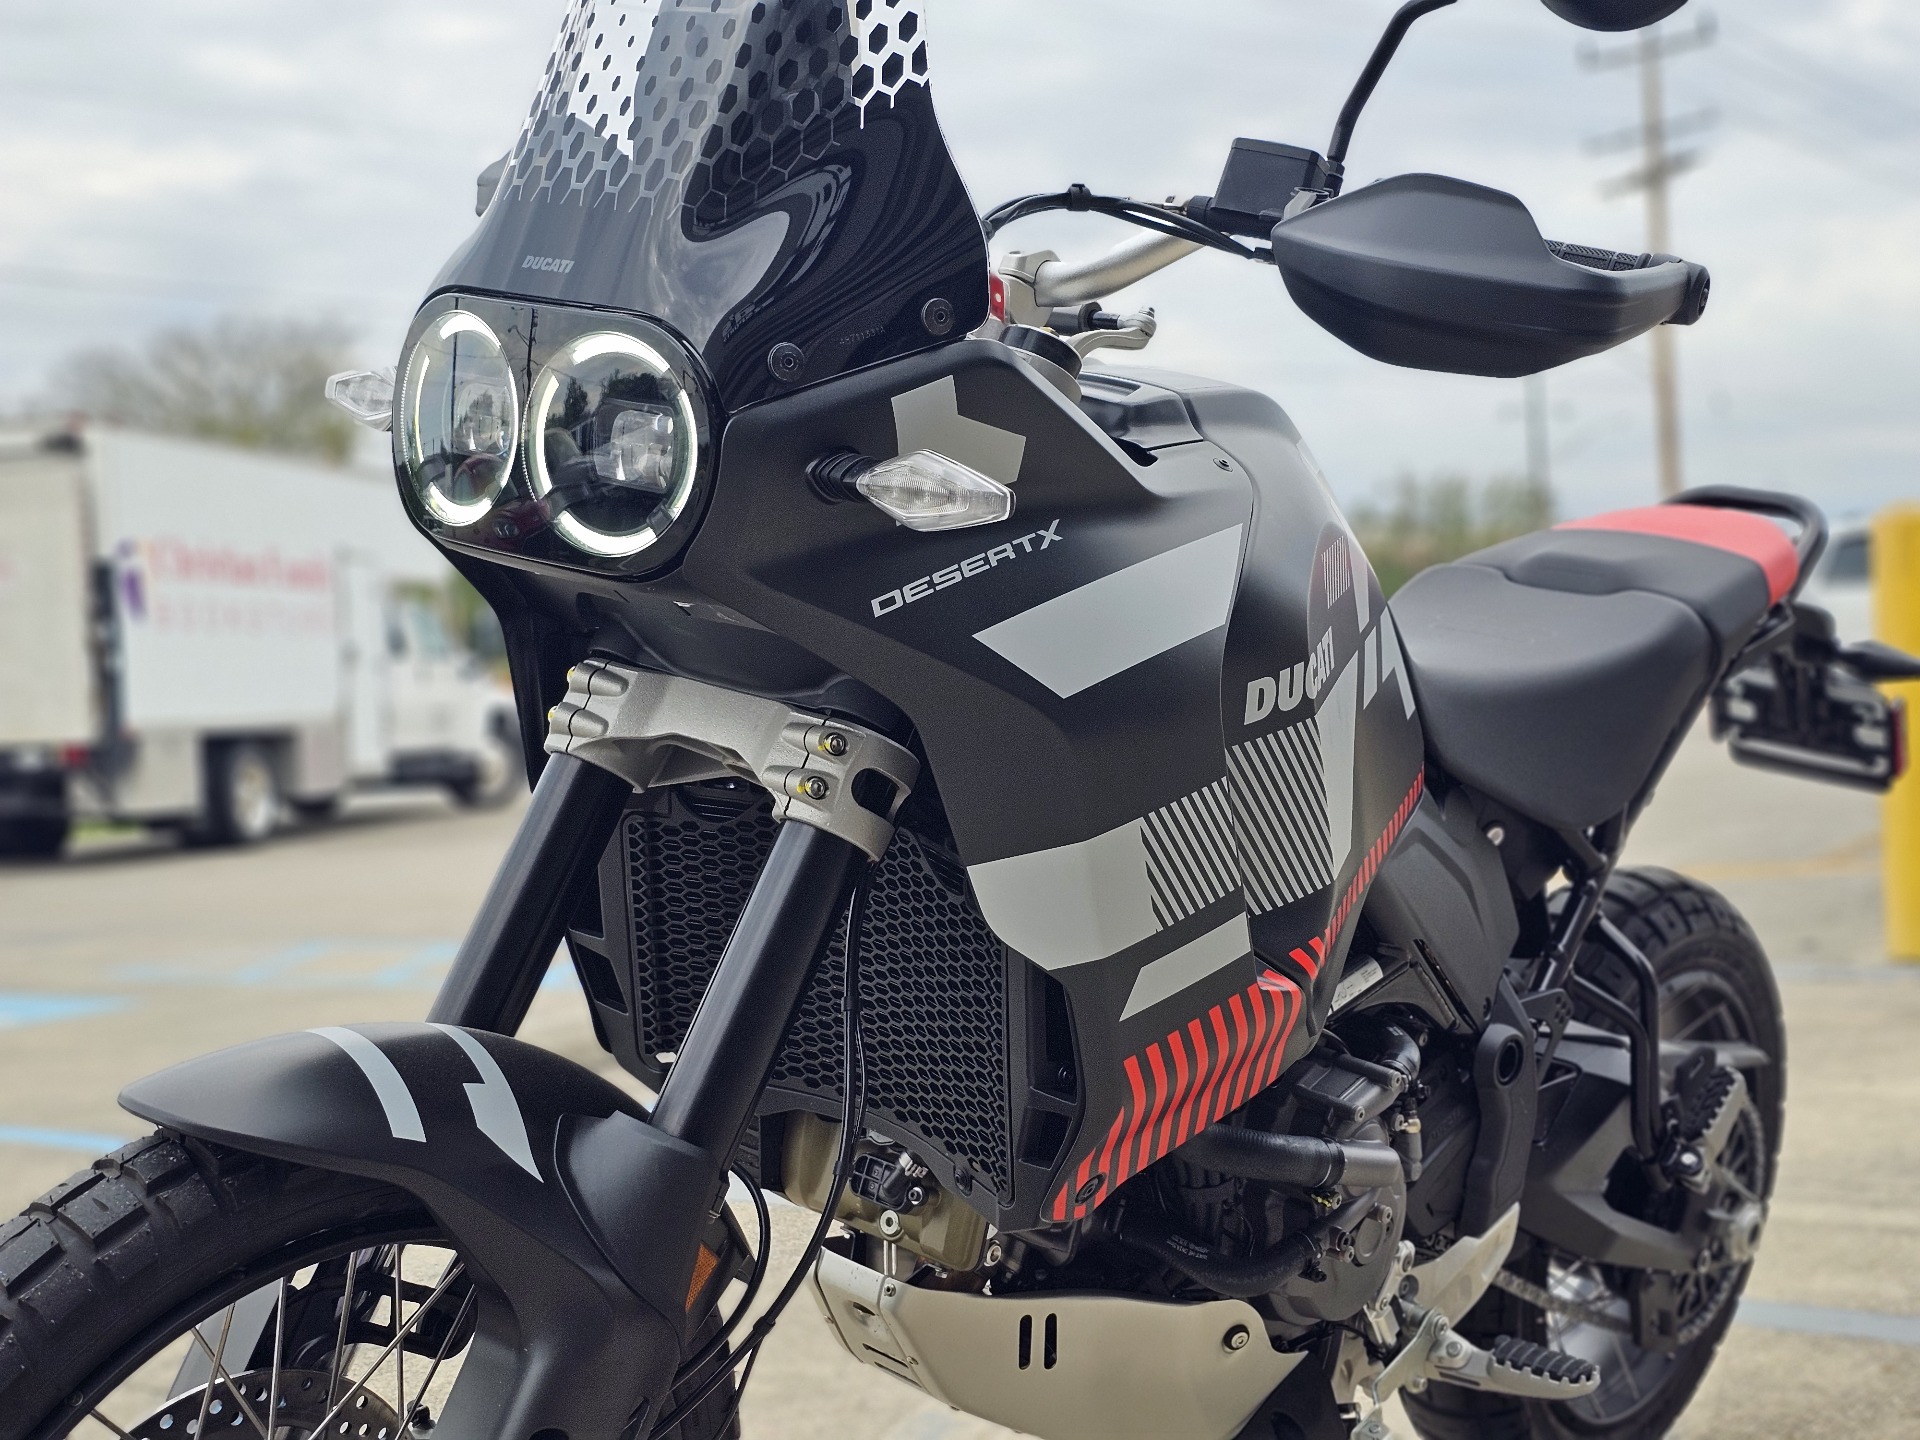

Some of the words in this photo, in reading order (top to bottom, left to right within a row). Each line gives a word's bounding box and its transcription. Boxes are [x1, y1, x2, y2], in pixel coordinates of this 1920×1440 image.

[521, 255, 576, 274] DUCATI
[870, 518, 1064, 619] DESERTX
[1243, 625, 1335, 726] DUCATI
